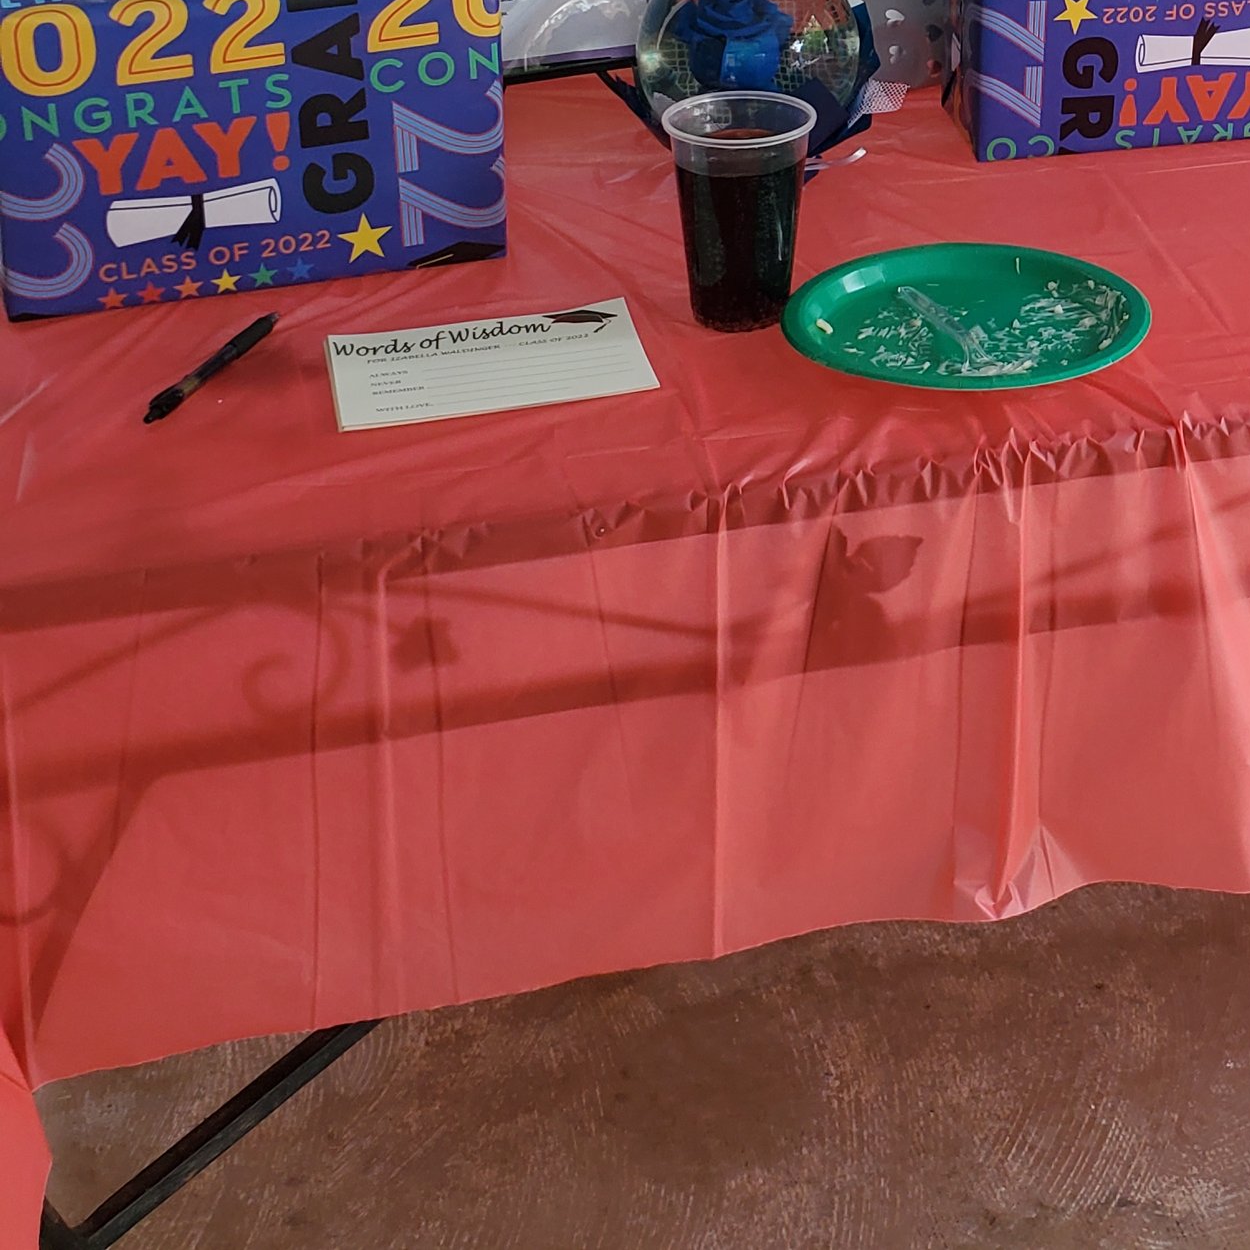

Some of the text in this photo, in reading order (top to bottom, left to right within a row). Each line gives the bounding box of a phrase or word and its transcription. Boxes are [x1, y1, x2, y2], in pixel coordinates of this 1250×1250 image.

[1103, 6, 1156, 24] 2022
[1165, 4, 1195, 21] OF
[0, 73, 293, 142] NGRATS
[72, 112, 292, 196] YAY!
[99, 230, 332, 283] CLASS OF 2022
[333, 321, 552, 358] Words of Wisdom
